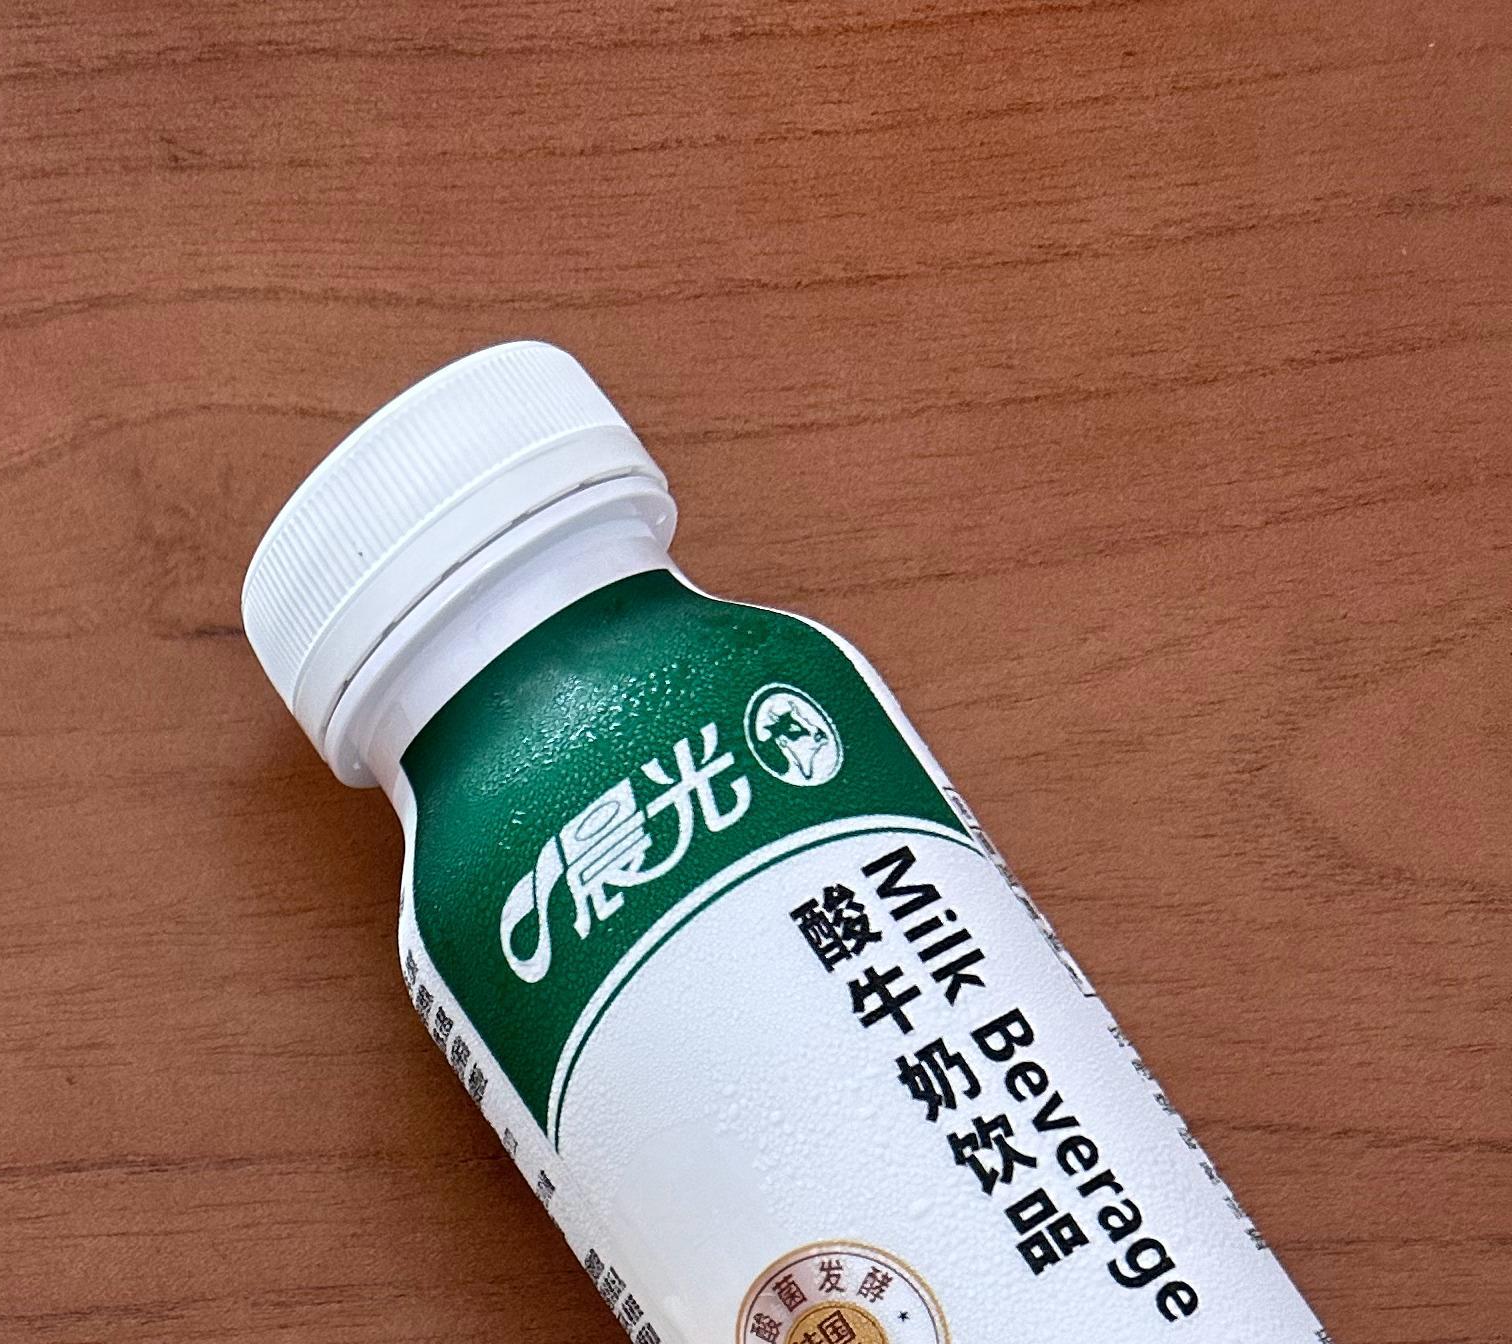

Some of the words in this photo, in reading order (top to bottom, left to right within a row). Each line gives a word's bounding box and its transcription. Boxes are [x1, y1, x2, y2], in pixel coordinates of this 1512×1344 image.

[500, 722, 752, 984] 晨光
[789, 883, 1090, 1276] 酸牛奶饮品
[860, 844, 986, 1007] Milk
[970, 1007, 1199, 1323] Beverage
